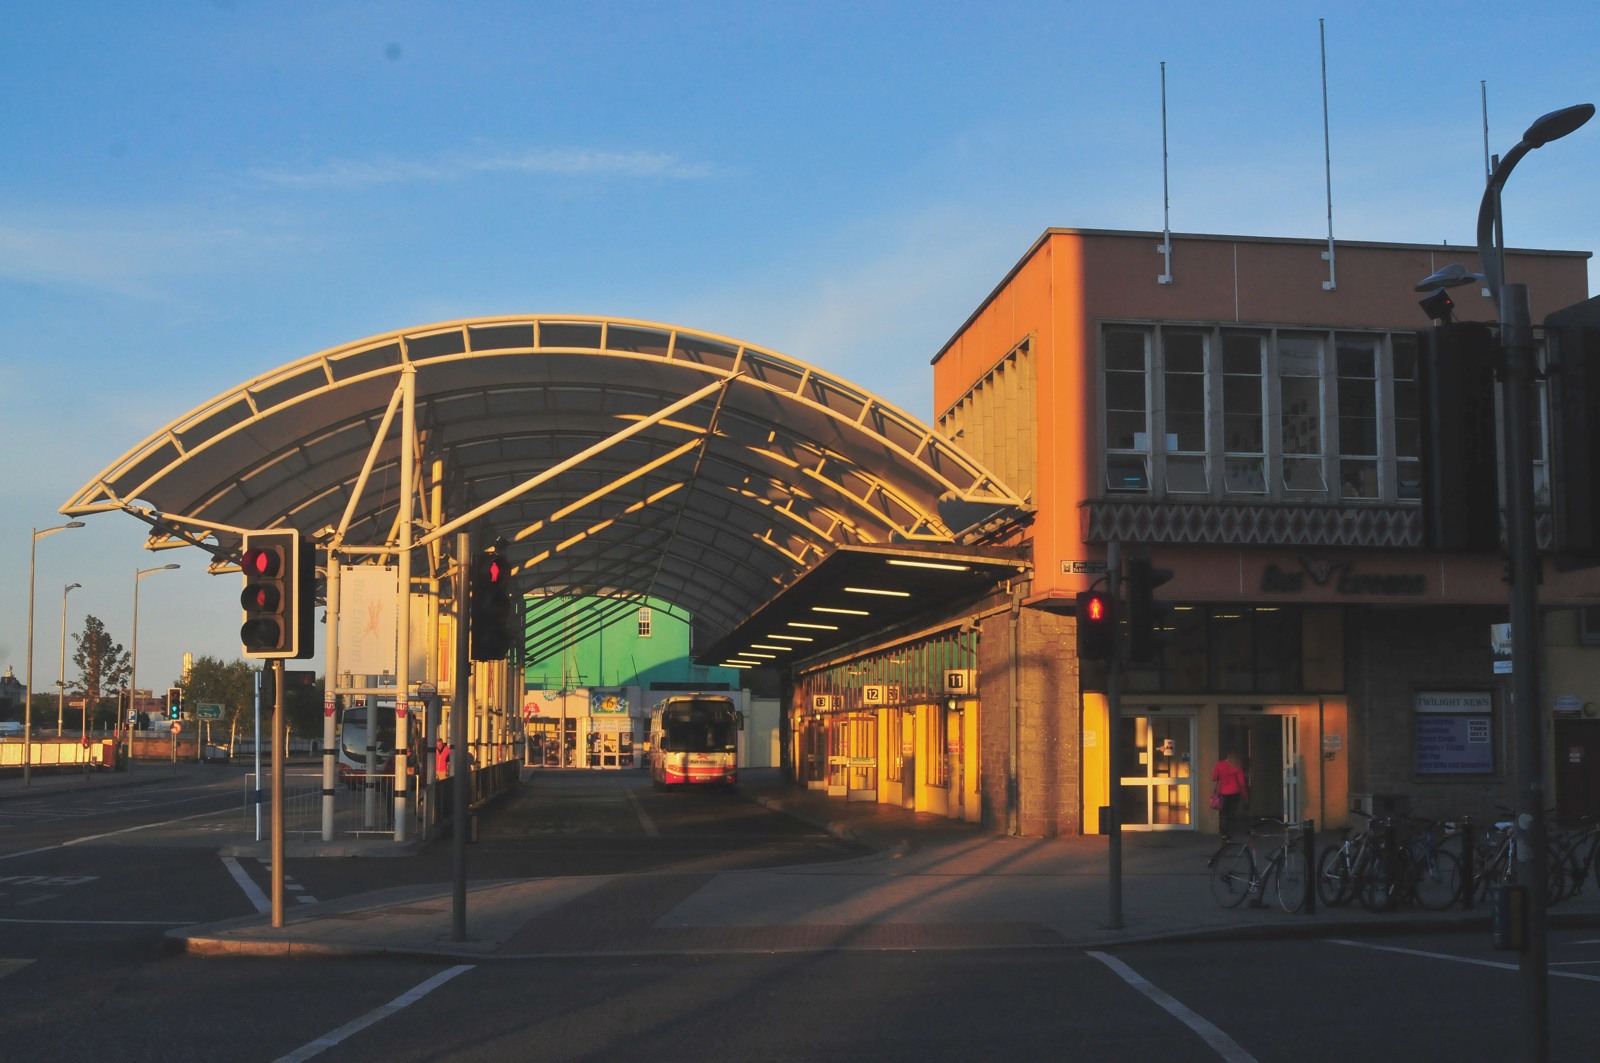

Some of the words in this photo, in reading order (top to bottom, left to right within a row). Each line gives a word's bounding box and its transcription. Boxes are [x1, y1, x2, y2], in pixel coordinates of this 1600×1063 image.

[950, 675, 963, 687] 11
[867, 690, 878, 699] 12
[816, 698, 826, 706] 13
[1416, 697, 1461, 707] TWILIGHT
[1463, 697, 1489, 707] NEWS
